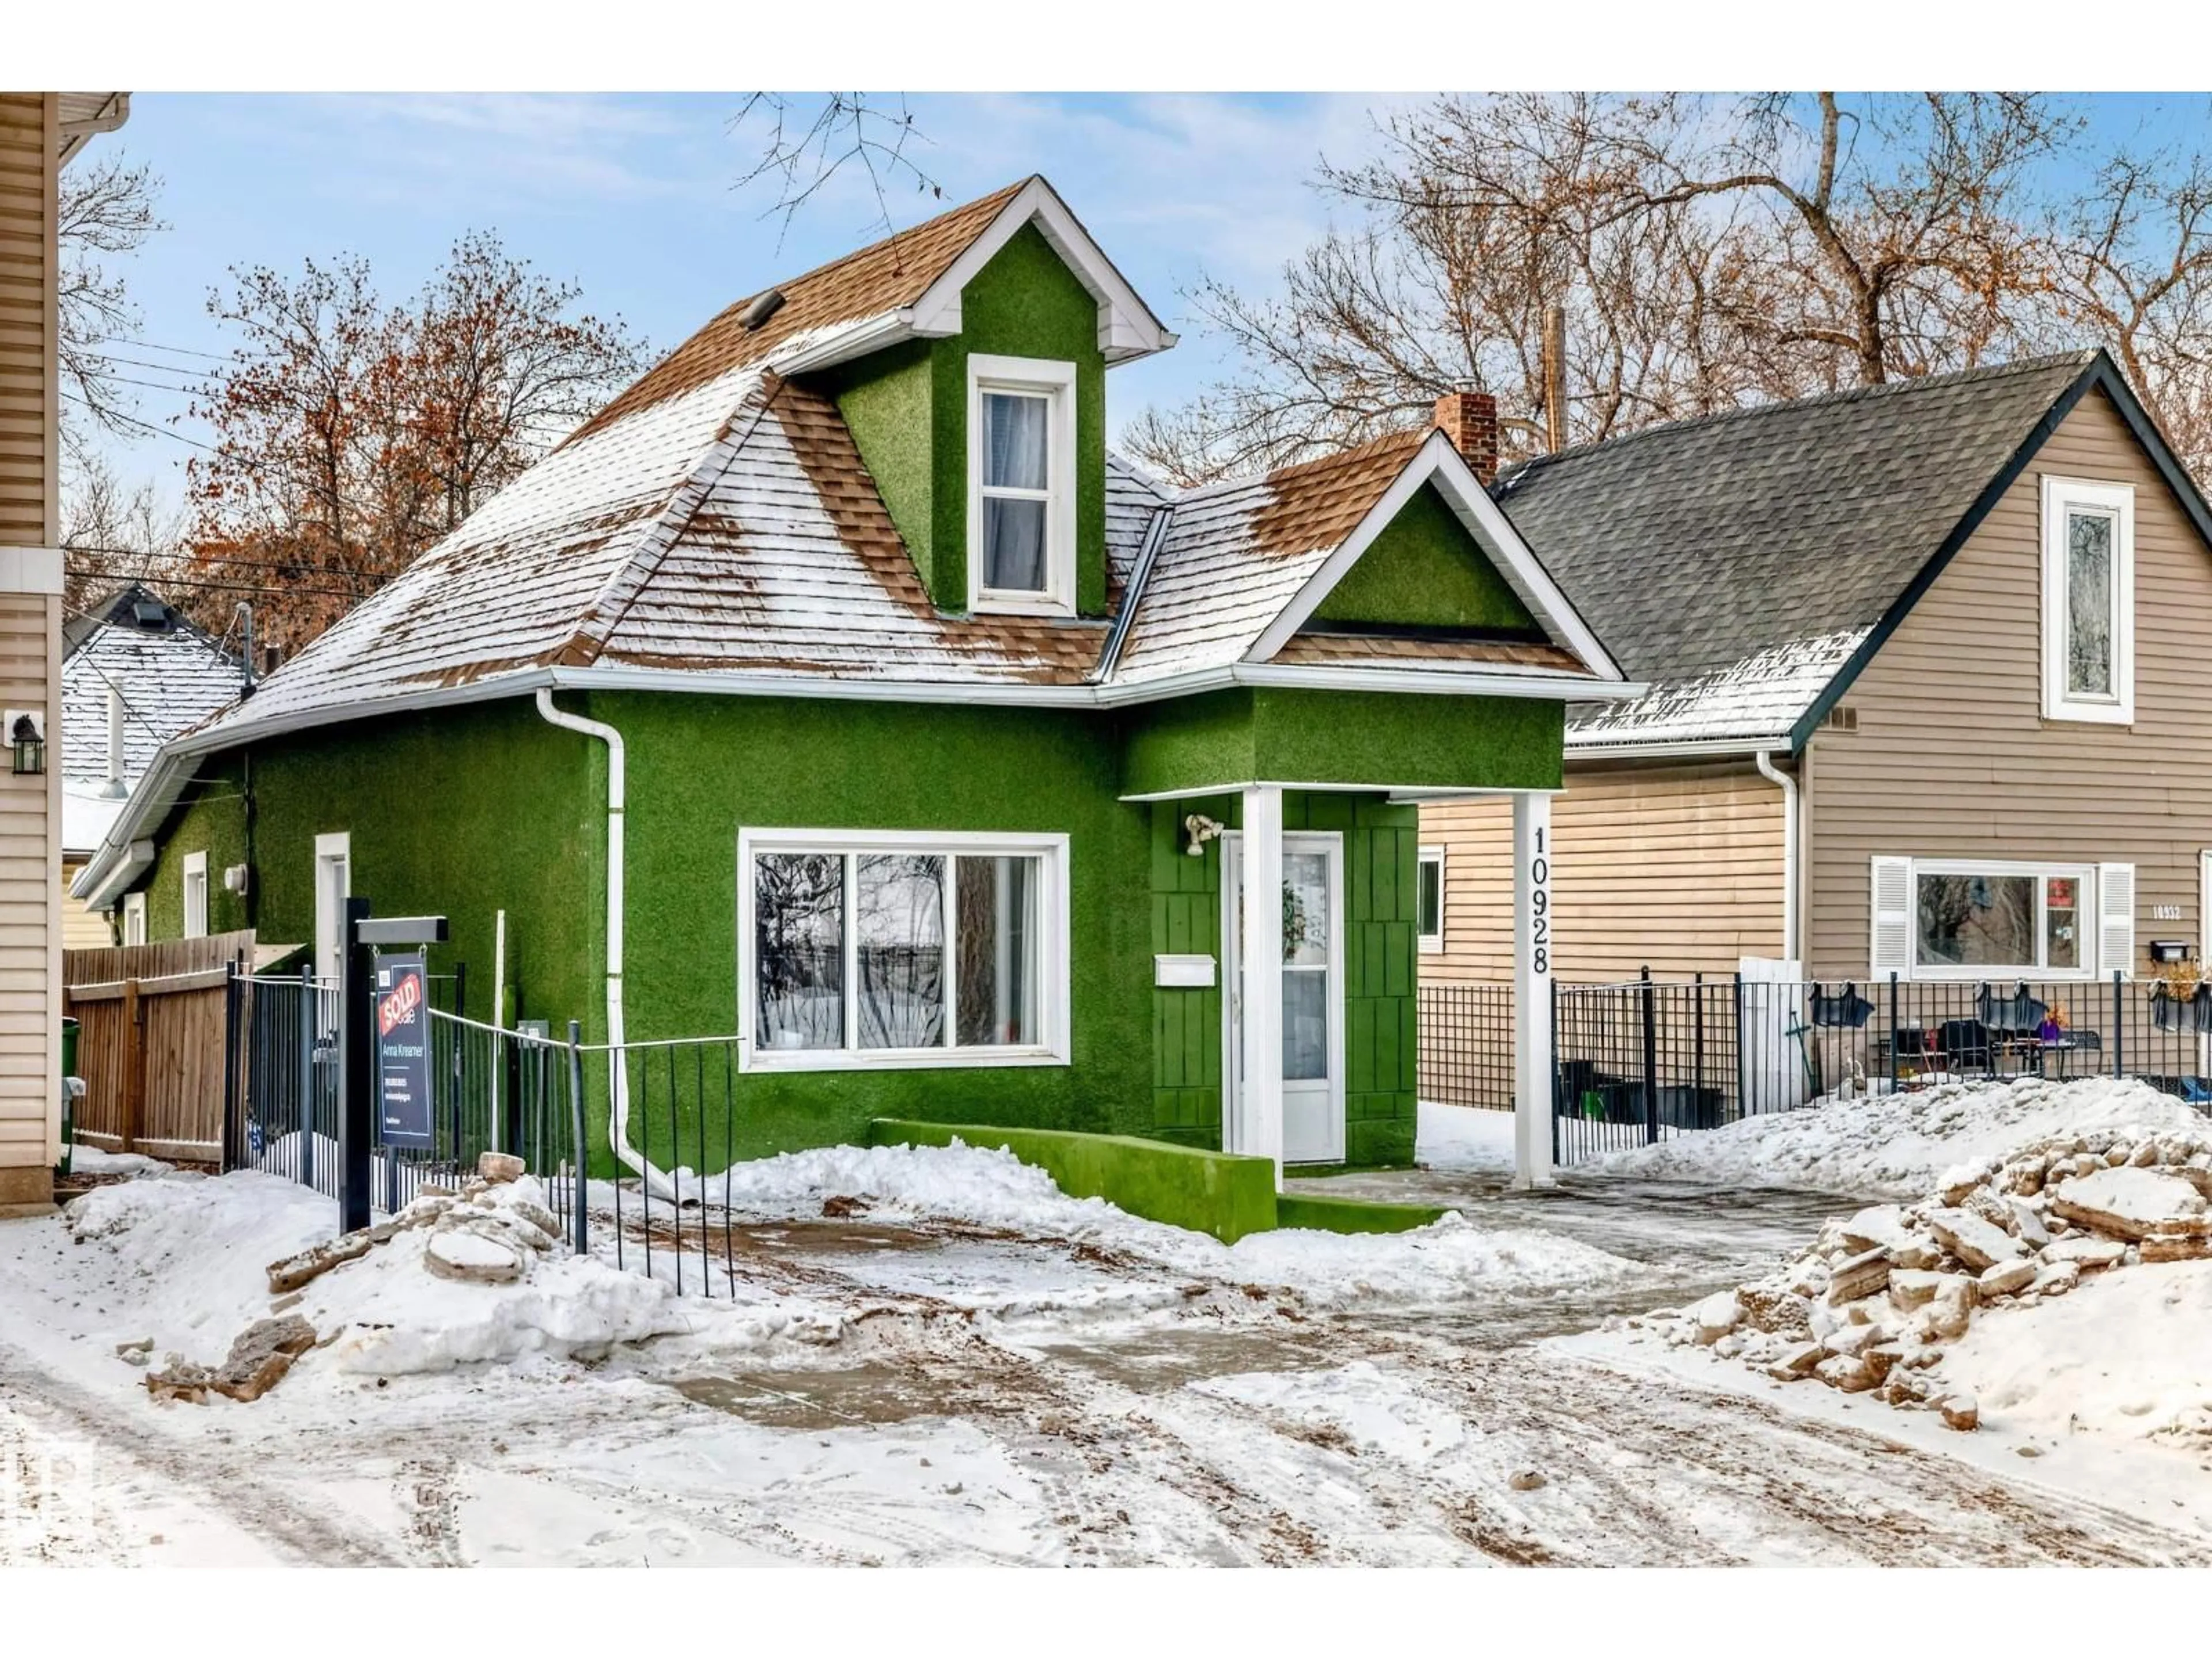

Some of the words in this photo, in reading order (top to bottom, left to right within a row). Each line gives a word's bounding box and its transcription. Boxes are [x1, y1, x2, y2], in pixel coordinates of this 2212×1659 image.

[1532, 827, 1548, 974] 10928
[2153, 905, 2181, 920] 10932
[384, 981, 415, 1029] SOLD
[383, 1043, 398, 1057] Anna
